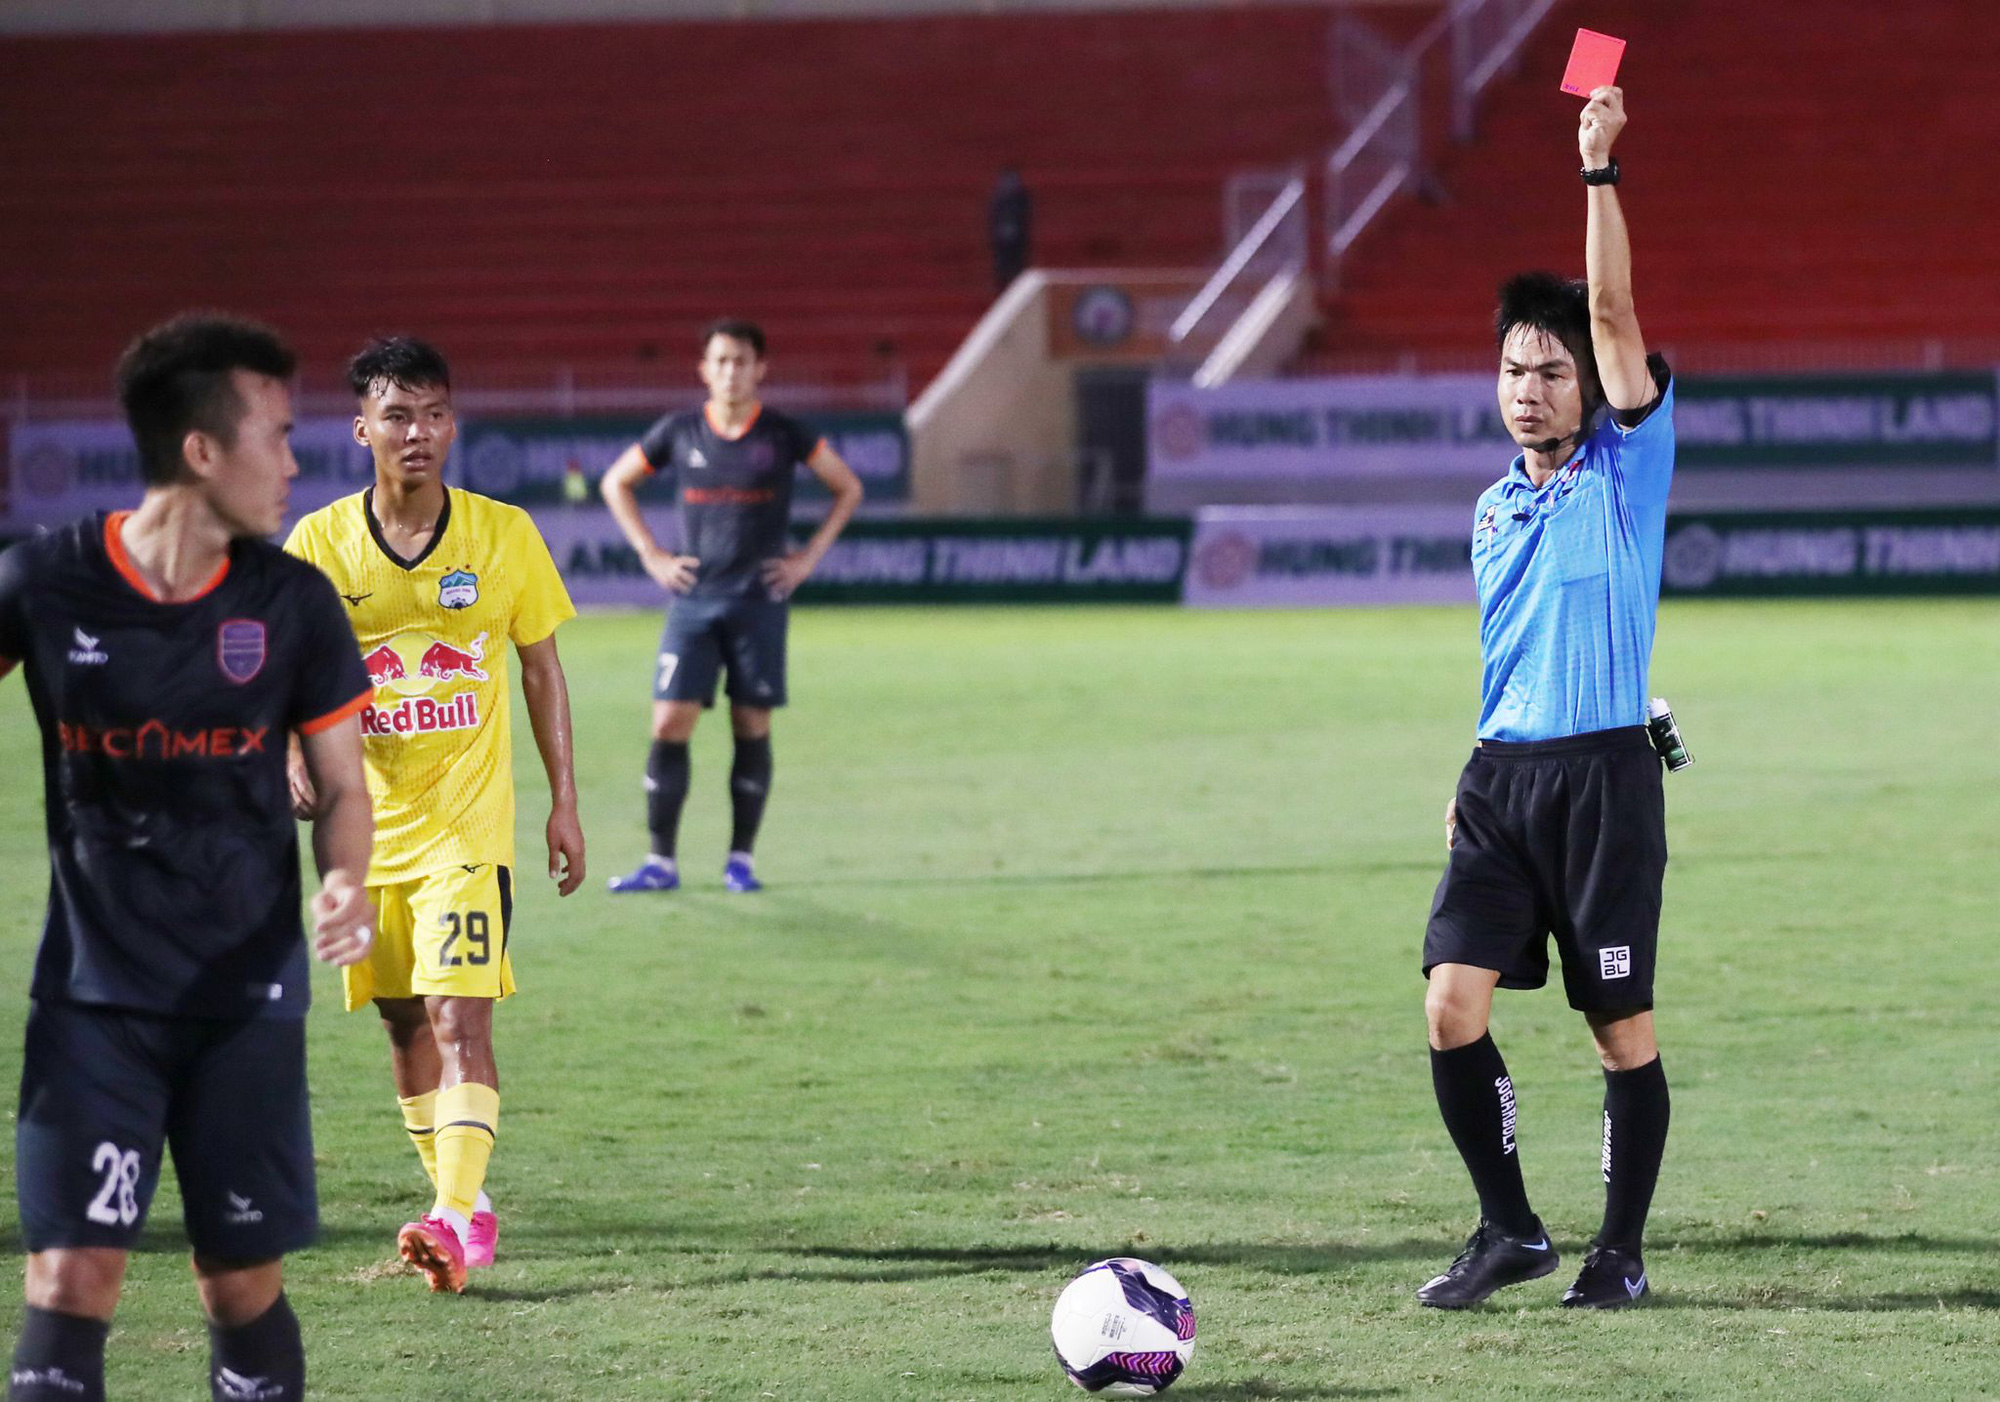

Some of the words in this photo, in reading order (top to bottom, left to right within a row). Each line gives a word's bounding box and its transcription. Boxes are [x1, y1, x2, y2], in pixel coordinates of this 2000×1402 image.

[658, 652, 678, 692] 7
[438, 911, 490, 966] 29
[1495, 1076, 1517, 1155] JOGARBOLA
[86, 1141, 140, 1226] 28
